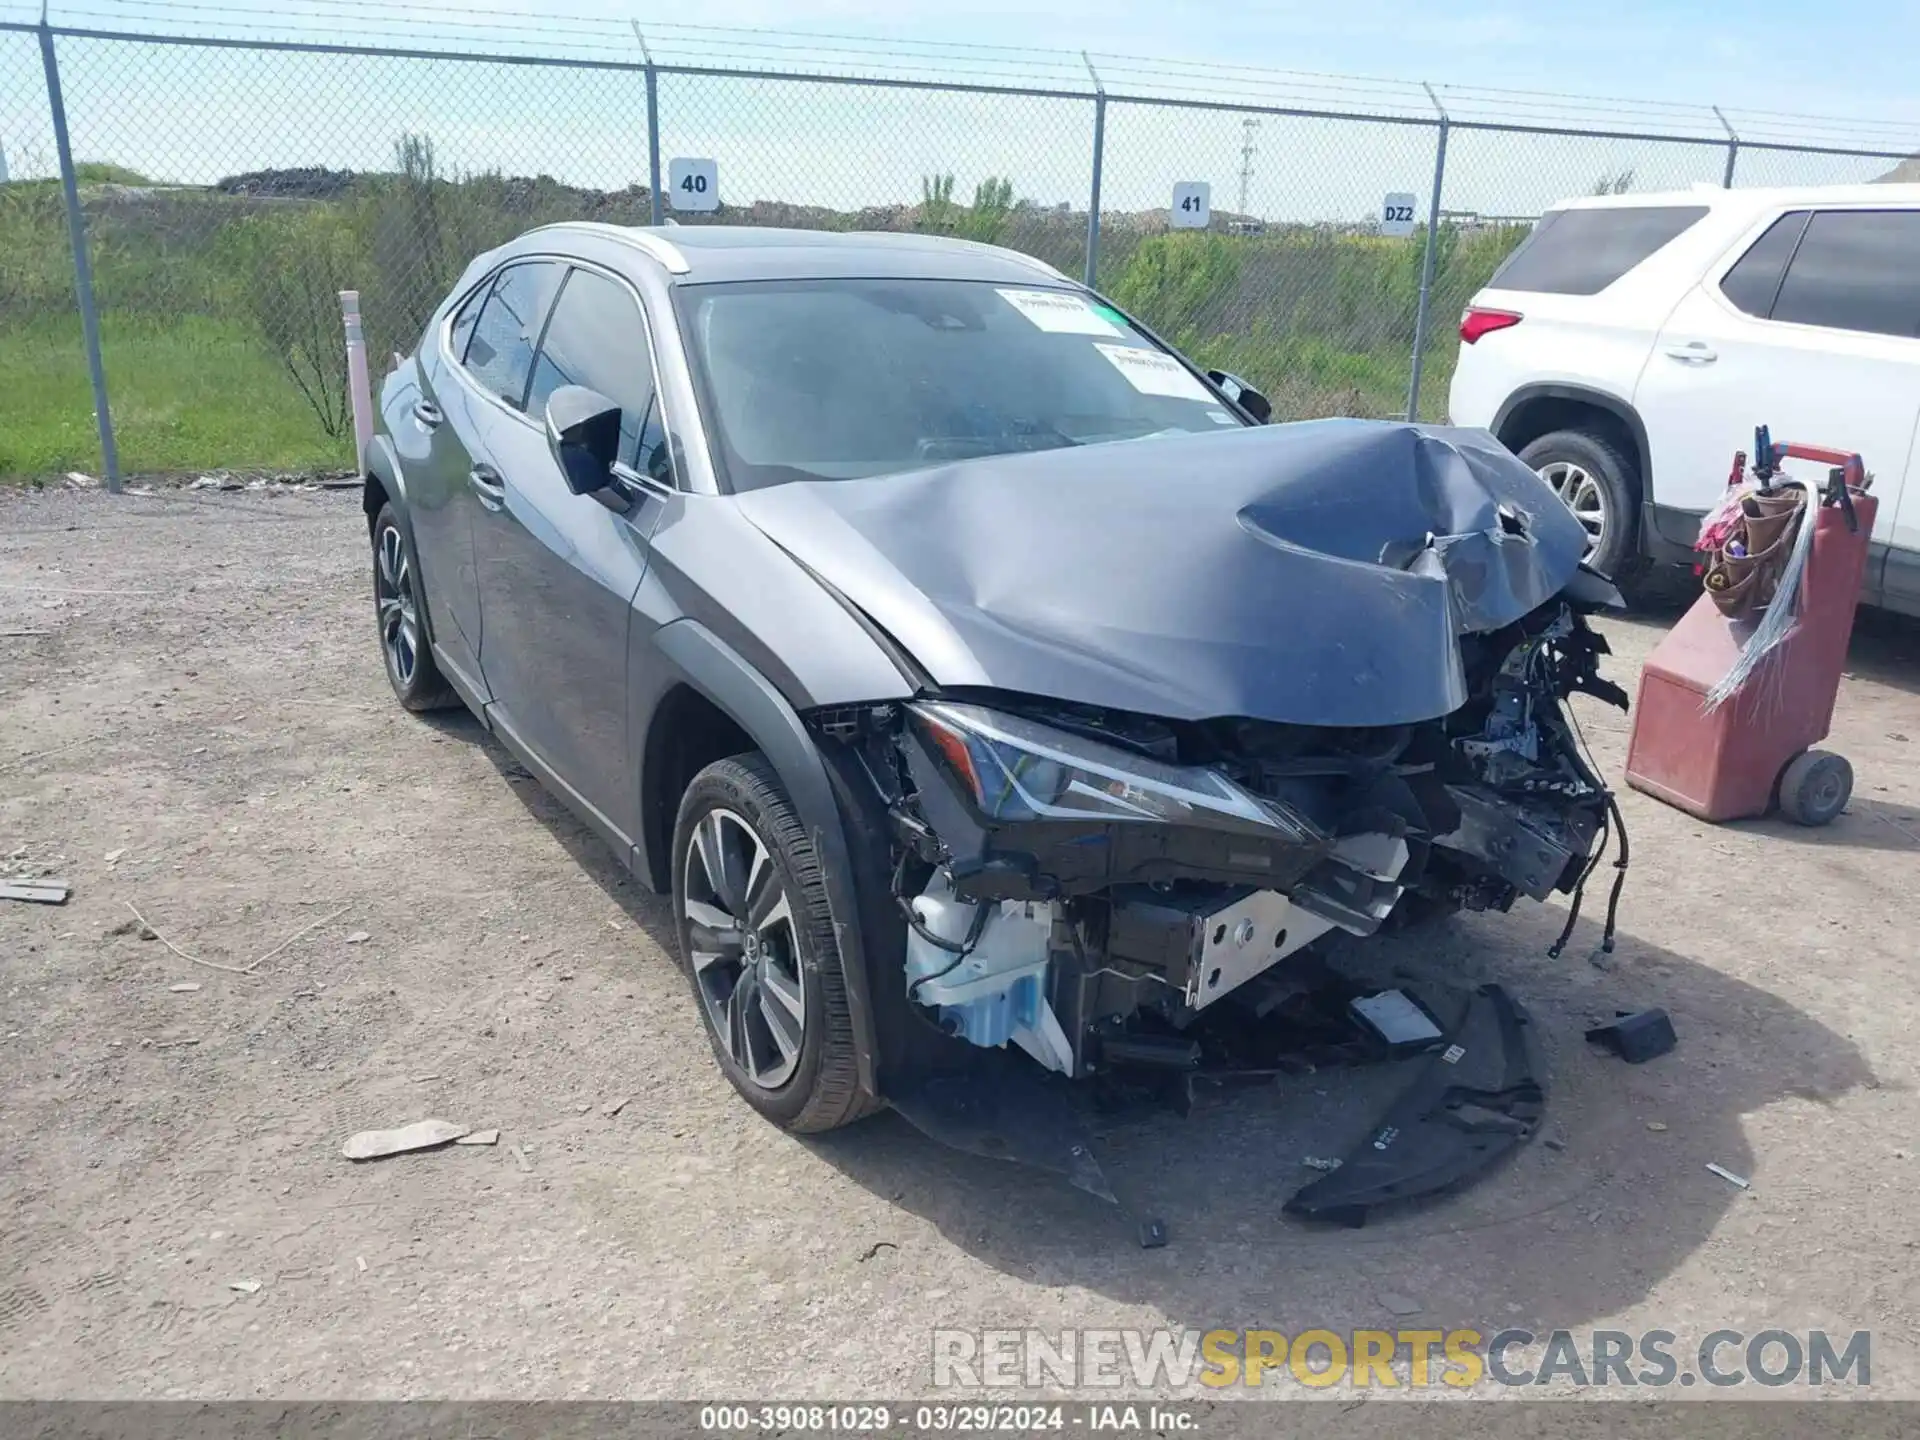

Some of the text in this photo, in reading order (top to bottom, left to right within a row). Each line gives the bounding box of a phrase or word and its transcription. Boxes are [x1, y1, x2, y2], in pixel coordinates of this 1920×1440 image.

[681, 175, 707, 193] 40
[1181, 196, 1201, 212] 41
[1385, 206, 1413, 222] DZ2
